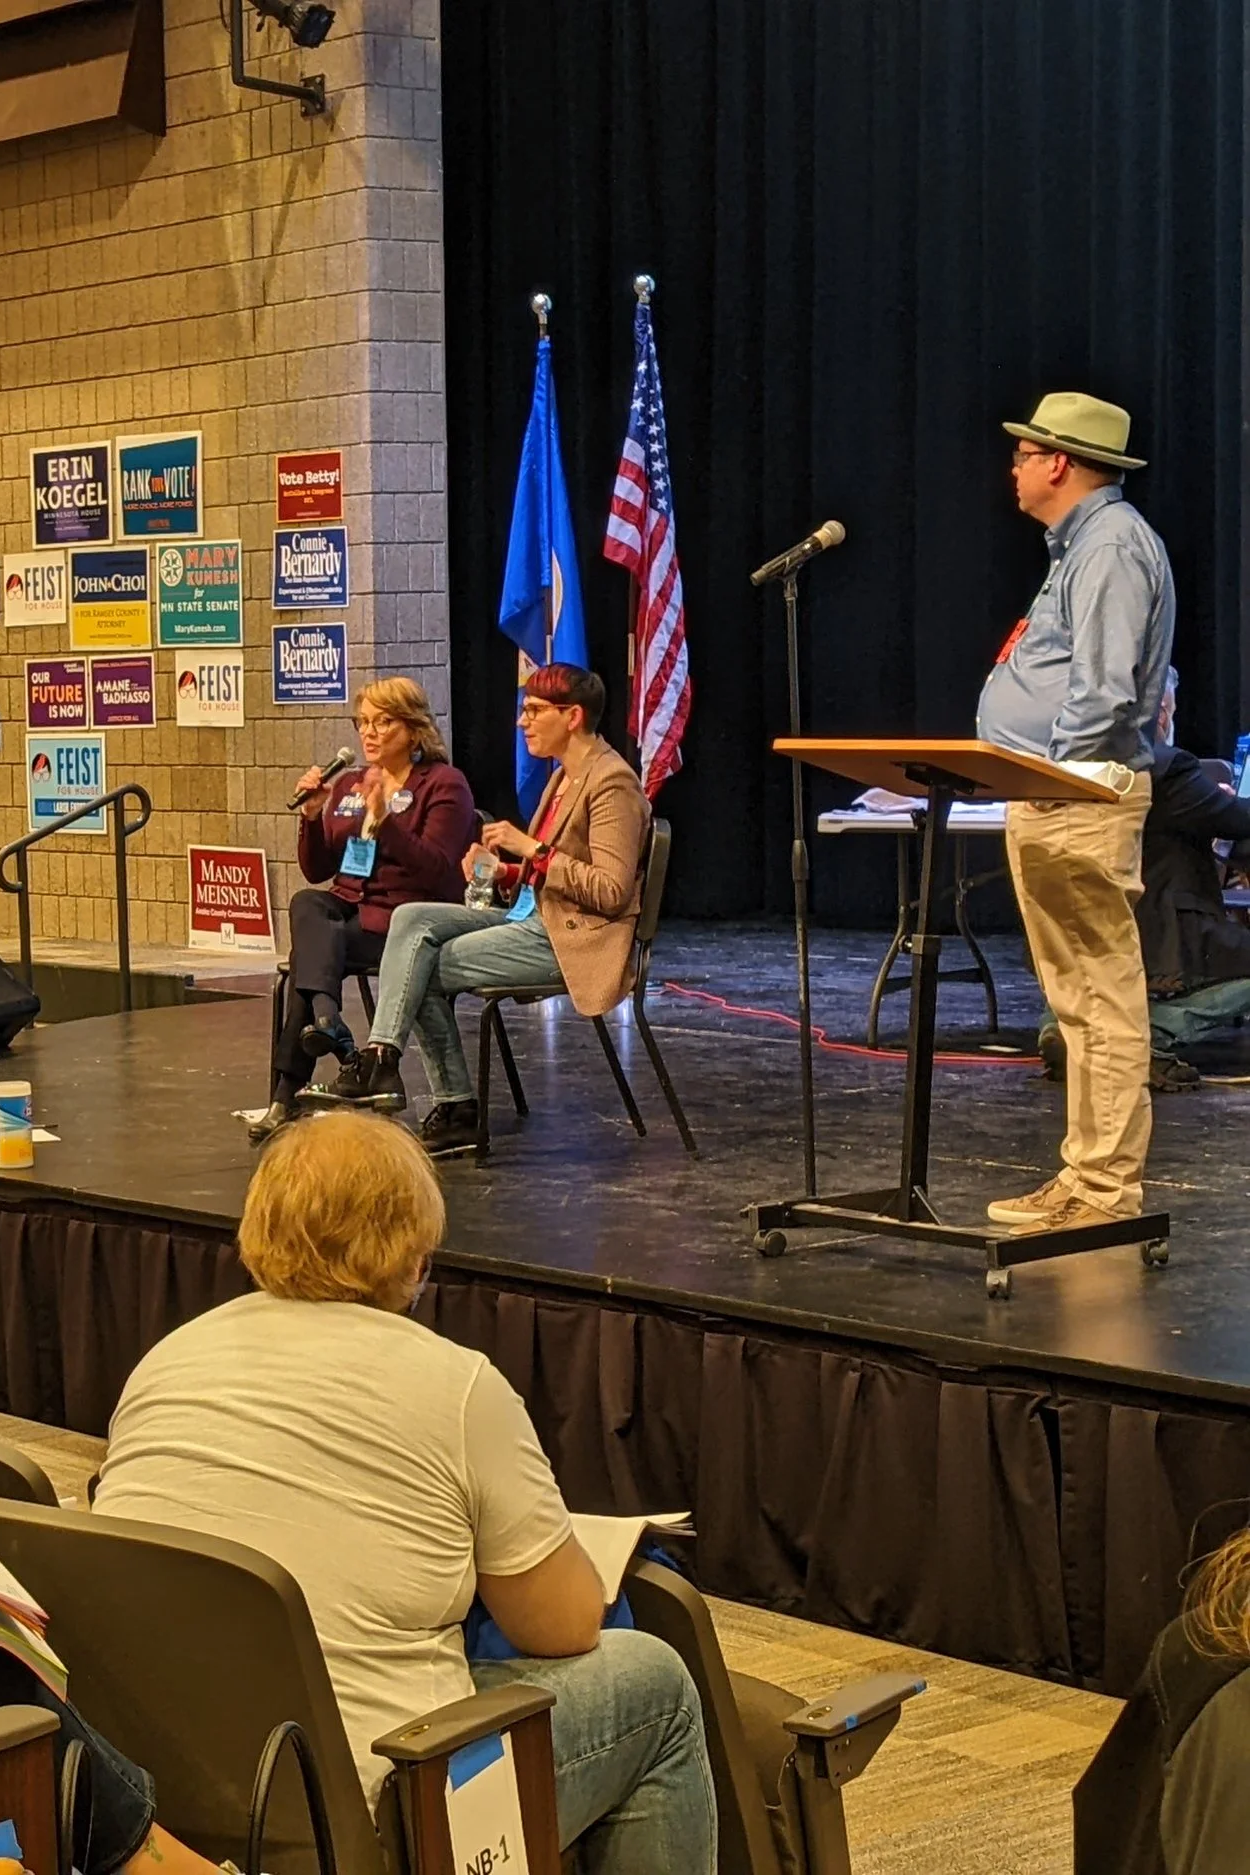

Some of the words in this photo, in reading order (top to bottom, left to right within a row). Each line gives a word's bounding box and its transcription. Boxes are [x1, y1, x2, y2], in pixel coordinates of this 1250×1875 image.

[47, 455, 93, 482] ERIN
[279, 472, 304, 486] Vote
[305, 468, 340, 486] Betty!
[123, 469, 152, 500] RANK
[163, 465, 196, 499] VOTE!
[36, 482, 108, 510] KOEGEL
[81, 508, 101, 517] HOUSE
[291, 532, 327, 552] Connie
[185, 546, 238, 568] MARY
[280, 543, 342, 584] Bernardy
[24, 566, 63, 601] FEIST
[74, 576, 108, 598] JOHN
[111, 573, 146, 592] CHOI
[186, 569, 238, 586] KUNESH
[194, 587, 205, 600] for
[161, 602, 174, 613] MN
[177, 601, 203, 612] STATE
[206, 600, 238, 611] SENATE
[291, 628, 326, 647] Connie
[279, 638, 341, 680] Bernardy
[31, 671, 50, 684] OUR
[95, 679, 130, 693] AMANE
[199, 665, 241, 701] FEIST
[32, 684, 83, 703] FUTURE
[103, 691, 150, 704] BADHASSO
[48, 706, 58, 718] IS
[59, 704, 84, 718] NOW
[215, 702, 239, 711] HOUSE
[57, 747, 99, 785] FEIST
[200, 859, 251, 884] MANDY
[196, 883, 261, 907] MEISNER
